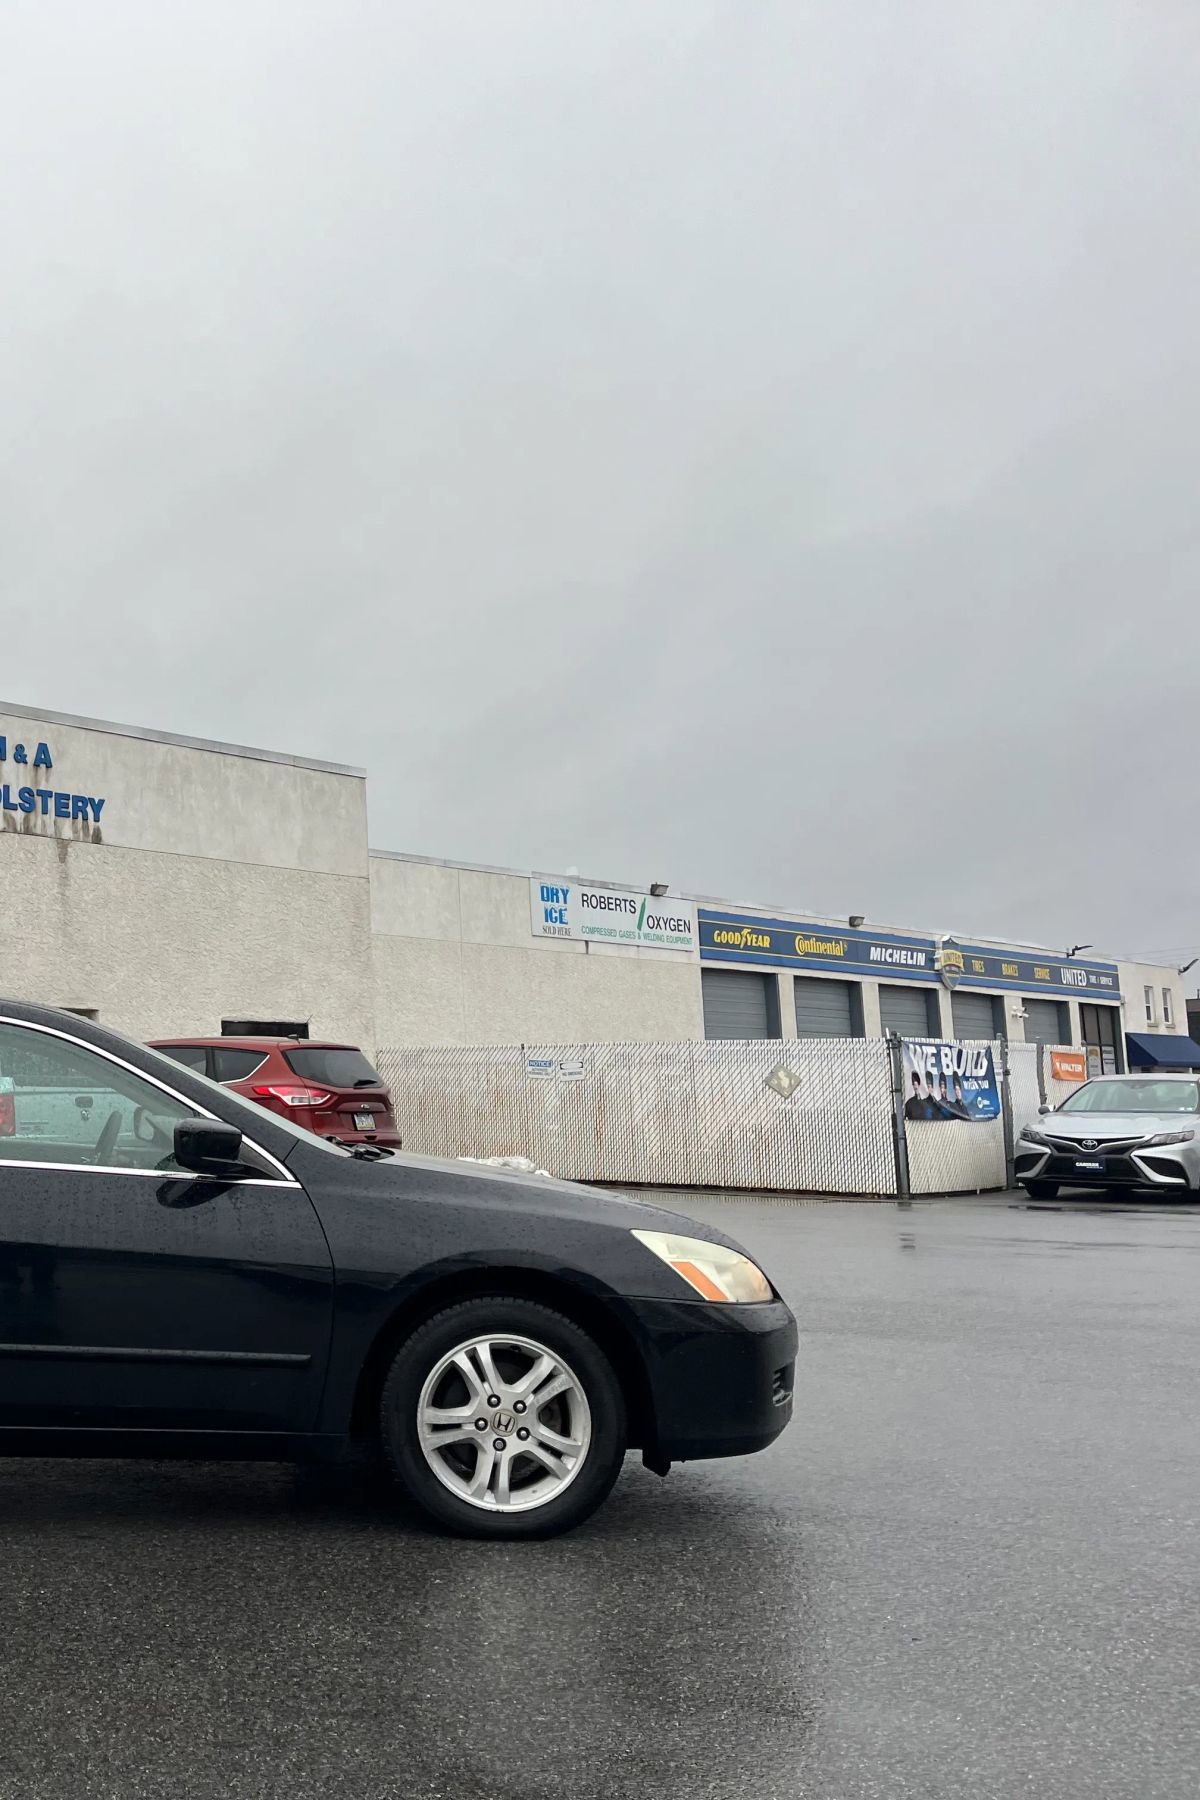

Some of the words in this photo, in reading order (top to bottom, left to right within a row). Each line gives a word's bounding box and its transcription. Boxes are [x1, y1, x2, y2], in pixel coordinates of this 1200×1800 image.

[13, 744, 28, 764] &
[33, 742, 53, 768] A
[540, 883, 570, 904] DRY
[581, 893, 637, 914] ROBERTS
[544, 906, 568, 925] ICE
[646, 914, 692, 933] OXYGEN
[542, 926, 557, 936] SOLD
[557, 927, 572, 937] HERE
[581, 925, 617, 937] COMPRESSED
[618, 929, 636, 940] GASES
[643, 932, 665, 942] WELDING
[666, 935, 693, 945] EQUIPMENT
[713, 928, 770, 949] GOODYEAR
[795, 935, 844, 956] Continental
[870, 946, 925, 966] MICHELIN
[1061, 968, 1087, 986] UNITED
[908, 1043, 938, 1075] WE
